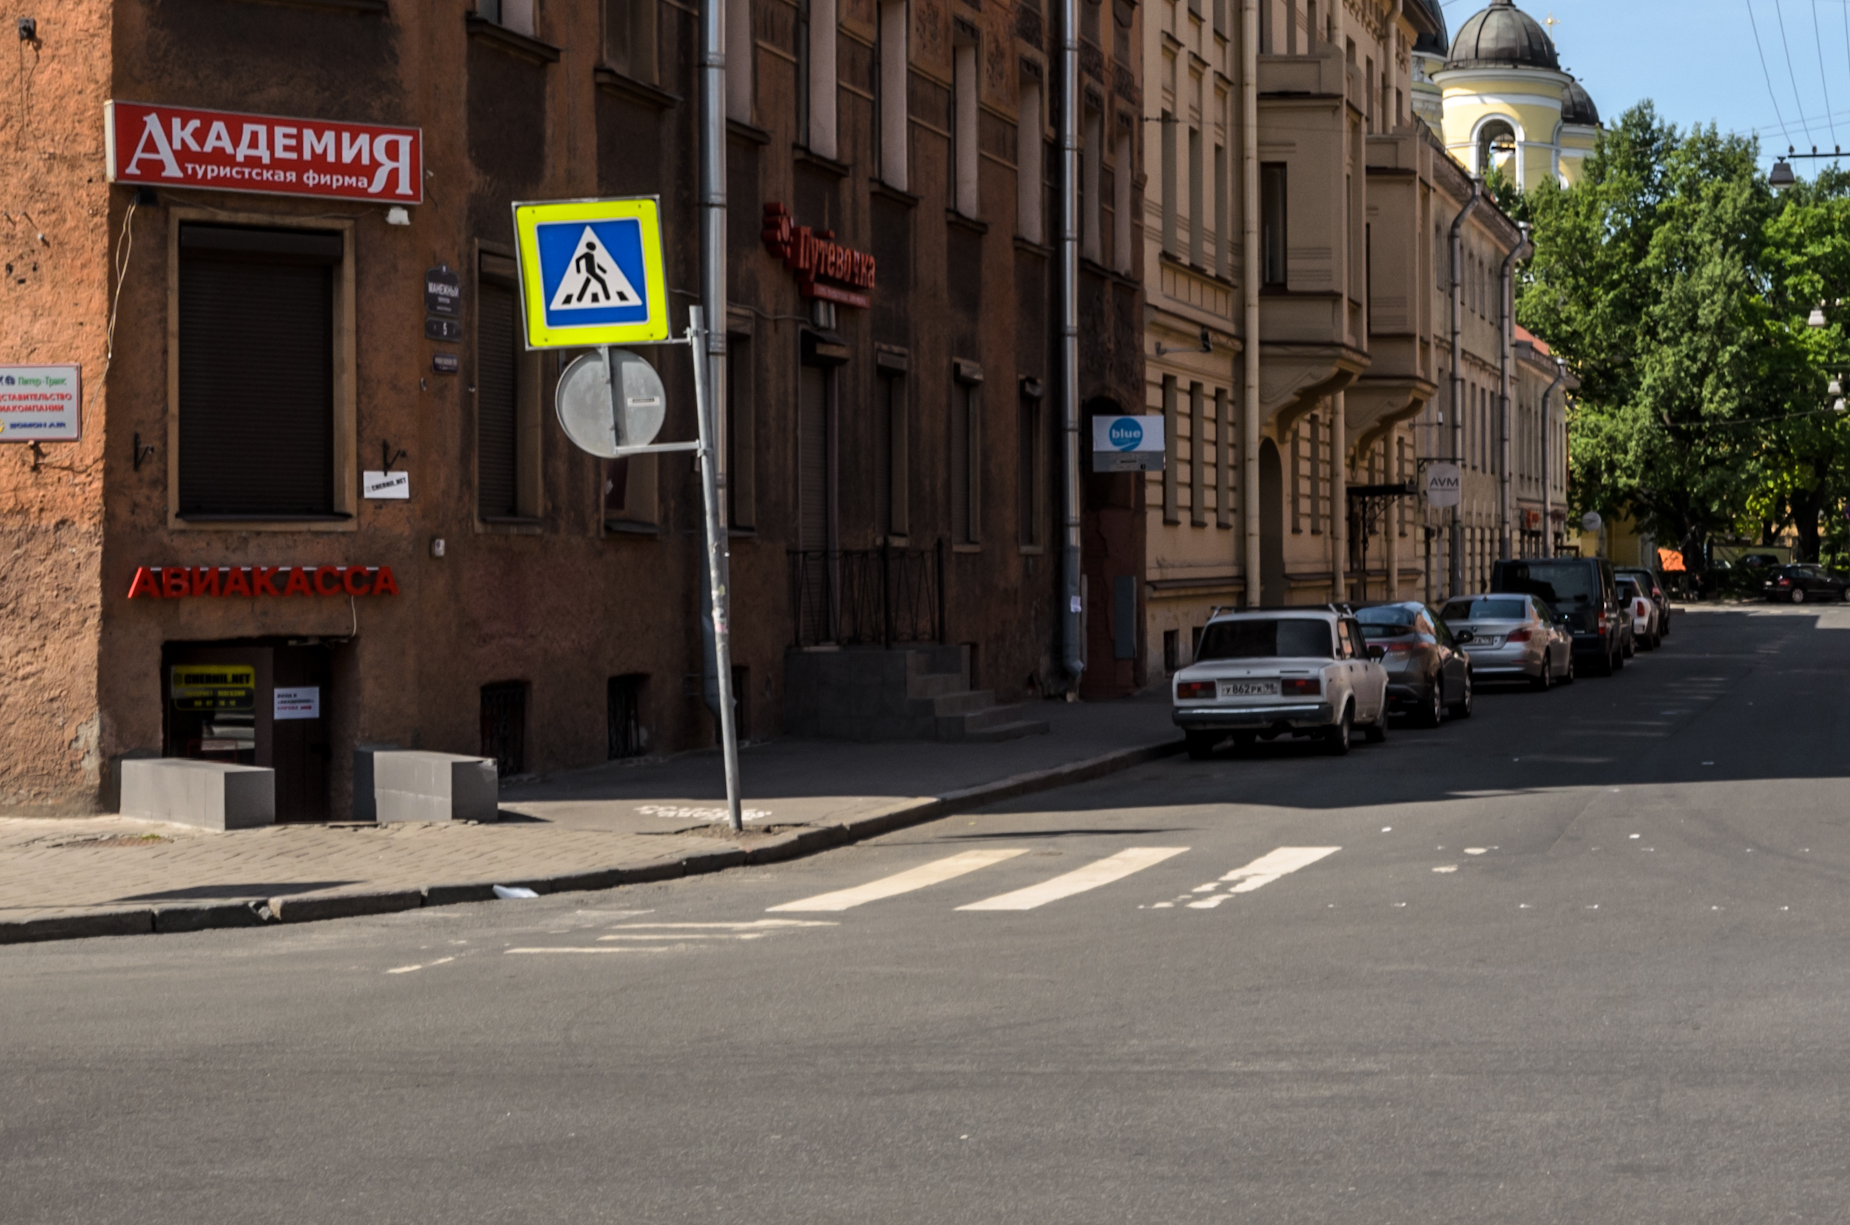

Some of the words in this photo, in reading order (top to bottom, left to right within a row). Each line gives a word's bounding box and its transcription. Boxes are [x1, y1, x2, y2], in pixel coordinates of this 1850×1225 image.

[125, 112, 414, 195] АКАДЕМИЯ
[184, 162, 297, 183] туристская
[303, 169, 368, 188] фирма
[0, 392, 72, 402] СТАВИТЕЛЬСТВО
[1111, 428, 1142, 439] blue
[1430, 477, 1459, 487] AVM
[127, 566, 400, 599] АВИАКАССА
[184, 674, 250, 684] CHERNIL.NET
